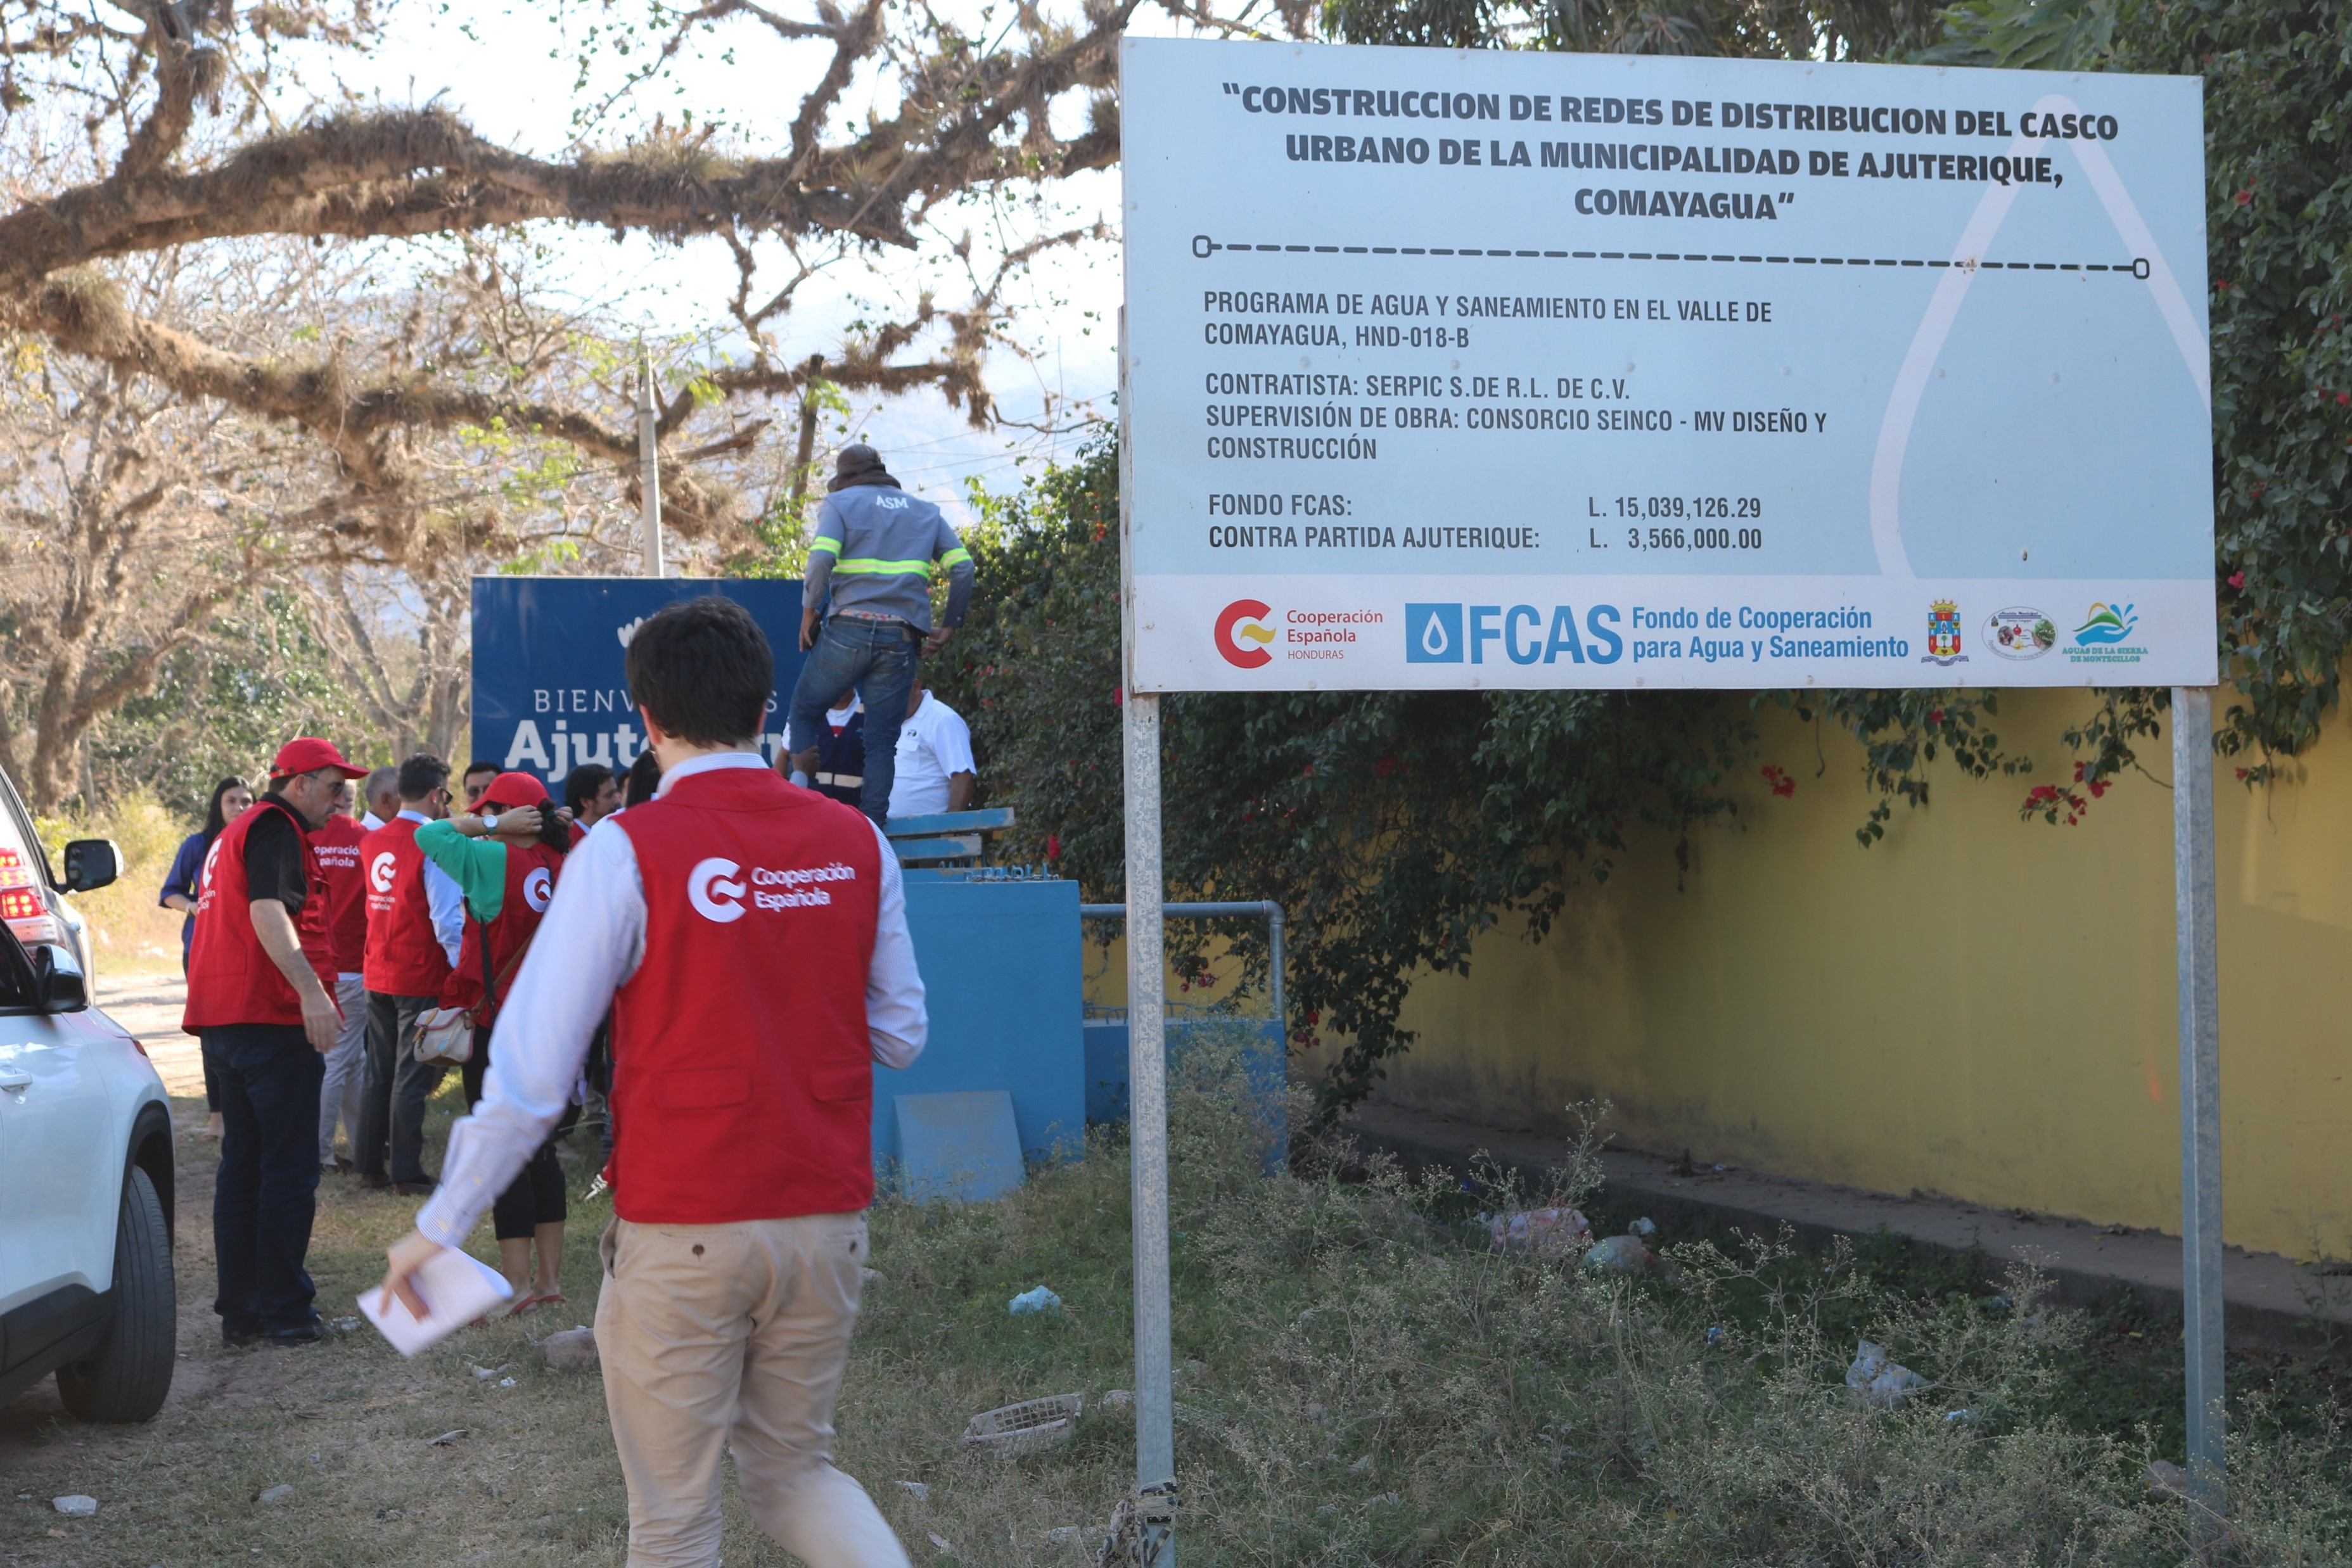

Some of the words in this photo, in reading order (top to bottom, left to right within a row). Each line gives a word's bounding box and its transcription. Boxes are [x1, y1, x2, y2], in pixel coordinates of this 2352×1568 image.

[1509, 94, 1552, 122] DE
[1561, 96, 1663, 125] REDES
[1671, 100, 1713, 127] DE
[1722, 102, 1946, 135] DISTRIBUCION
[1955, 110, 2012, 137] DEL
[2020, 112, 2118, 141] CASCO
[1286, 134, 1429, 165] URBANO
[1439, 139, 1481, 166] DE
[1490, 140, 1532, 167] LA
[1540, 141, 1800, 175] MUNICIPALIDAD
[1808, 150, 1849, 177] DE
[1857, 152, 2063, 189] AJUTERIQUE,
[1205, 291, 1329, 314] PROGRAMA
[1336, 293, 1364, 315] DE
[1371, 294, 1429, 316] AGUA
[1435, 295, 1449, 316] Y
[1456, 295, 1606, 319] SANEAMIENTO
[1614, 299, 1639, 320] EN
[1647, 300, 1671, 321] EL
[1677, 300, 1739, 322] VALLE
[1746, 302, 1772, 322] DE
[1205, 322, 1346, 350] COMAYAGUA,
[1356, 326, 1469, 348] HND-018-B
[1206, 373, 1358, 396] CONTRATISTA:
[1366, 374, 1443, 397] SERPIC
[1557, 378, 1583, 398] DE
[1590, 378, 1630, 399] C.V.
[1206, 401, 1352, 428] SUPERVISIÓN
[1360, 407, 1387, 428] DE
[1395, 407, 1459, 428] OBRA:
[1467, 407, 1589, 430] CONSORCIO
[1597, 409, 1672, 431] SEINCO
[1694, 411, 1725, 431] MV
[1733, 408, 1807, 433] DISEÑO
[1814, 412, 1827, 433] Y
[1207, 433, 1376, 460] CONSTRUCCIÓN
[876, 495, 909, 509] ASM
[1209, 494, 1283, 516] FONDO
[1291, 494, 1352, 516] FCAS:
[1588, 496, 1607, 517] L.
[1615, 497, 1761, 521] 15,039,126.29
[1209, 526, 1298, 548] CONTRA
[1305, 526, 1396, 547] PARTIDA
[1402, 526, 1539, 549] AJUTERIQUE:
[1590, 528, 1607, 548] L.
[1628, 528, 1761, 552] 3,566,000.00
[1287, 609, 1383, 626] Cooperación
[1632, 606, 1699, 628] Fondo
[1706, 606, 1731, 628] de
[1739, 606, 1872, 633] Cooperación
[1288, 628, 1356, 645] Española
[1469, 604, 1623, 665] FCAS
[1288, 650, 1344, 659] HONDURAS
[1633, 637, 1682, 663] para
[1689, 636, 1744, 663] Agua
[1751, 640, 1763, 662] y
[1770, 635, 1908, 658] Saneamiento
[319, 856, 355, 867] pañola
[750, 862, 855, 888] Cooperación
[753, 886, 831, 912] Española
